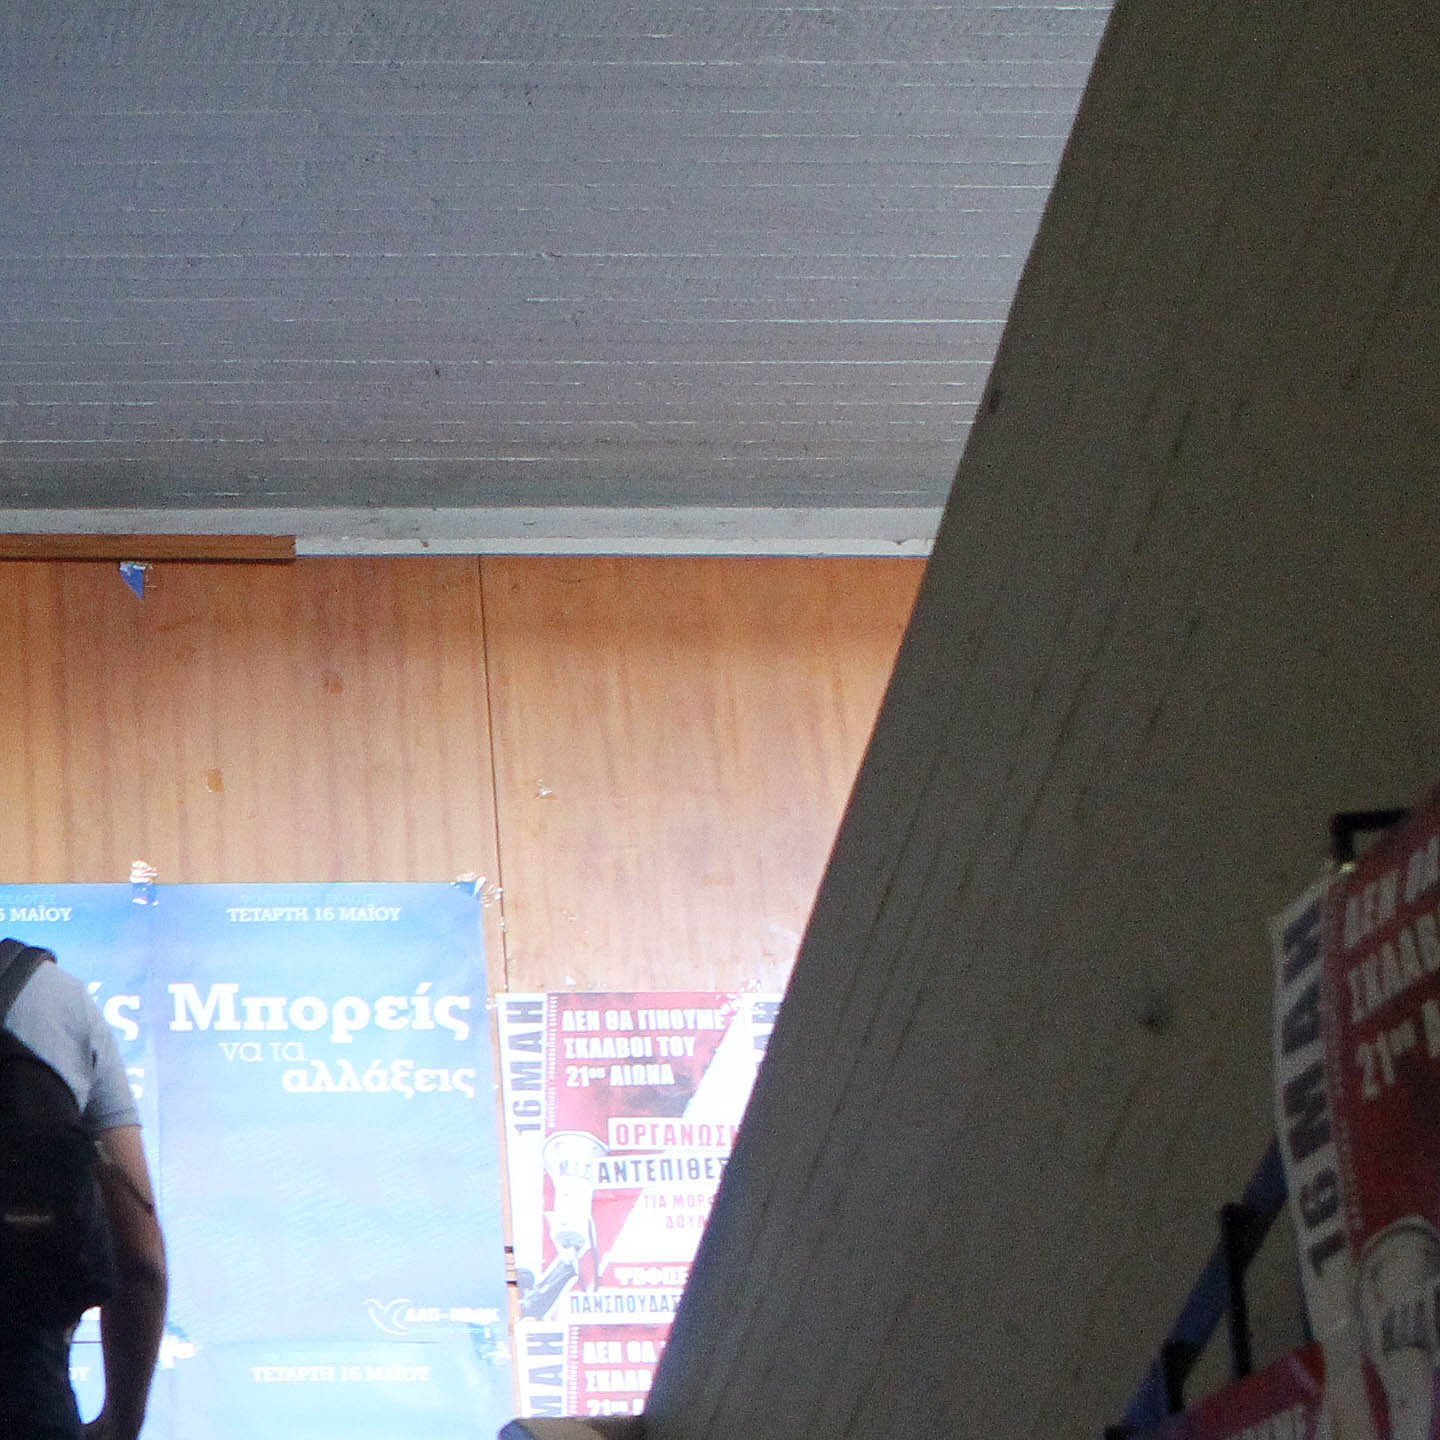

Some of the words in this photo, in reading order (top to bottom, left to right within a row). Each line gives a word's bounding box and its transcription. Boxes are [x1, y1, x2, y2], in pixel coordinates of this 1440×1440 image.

[10, 904, 73, 922] ΜΑΪΟΥ
[227, 908, 309, 923] ΤΕΤΑΡΤΗ
[314, 907, 335, 922] 16
[339, 905, 401, 922] ΜΑΪΟΥ
[168, 981, 471, 1044] Μπορείς
[561, 1009, 603, 1032] ΔΕΝ
[606, 1009, 635, 1031] ΘΑ
[637, 1008, 727, 1031] ΓΙΝΟΥΜΕ
[219, 1041, 263, 1063] να
[269, 1040, 305, 1062] τα
[562, 1036, 653, 1060] ΣΚΛΑΒΟΙ
[655, 1035, 697, 1058] ΤΟΥ
[282, 1058, 477, 1099] αλλάξεις
[506, 999, 544, 1134] 16ΜΑΗ
[597, 1157, 730, 1186] ΑΝΤΕΠΙΘΕΣ
